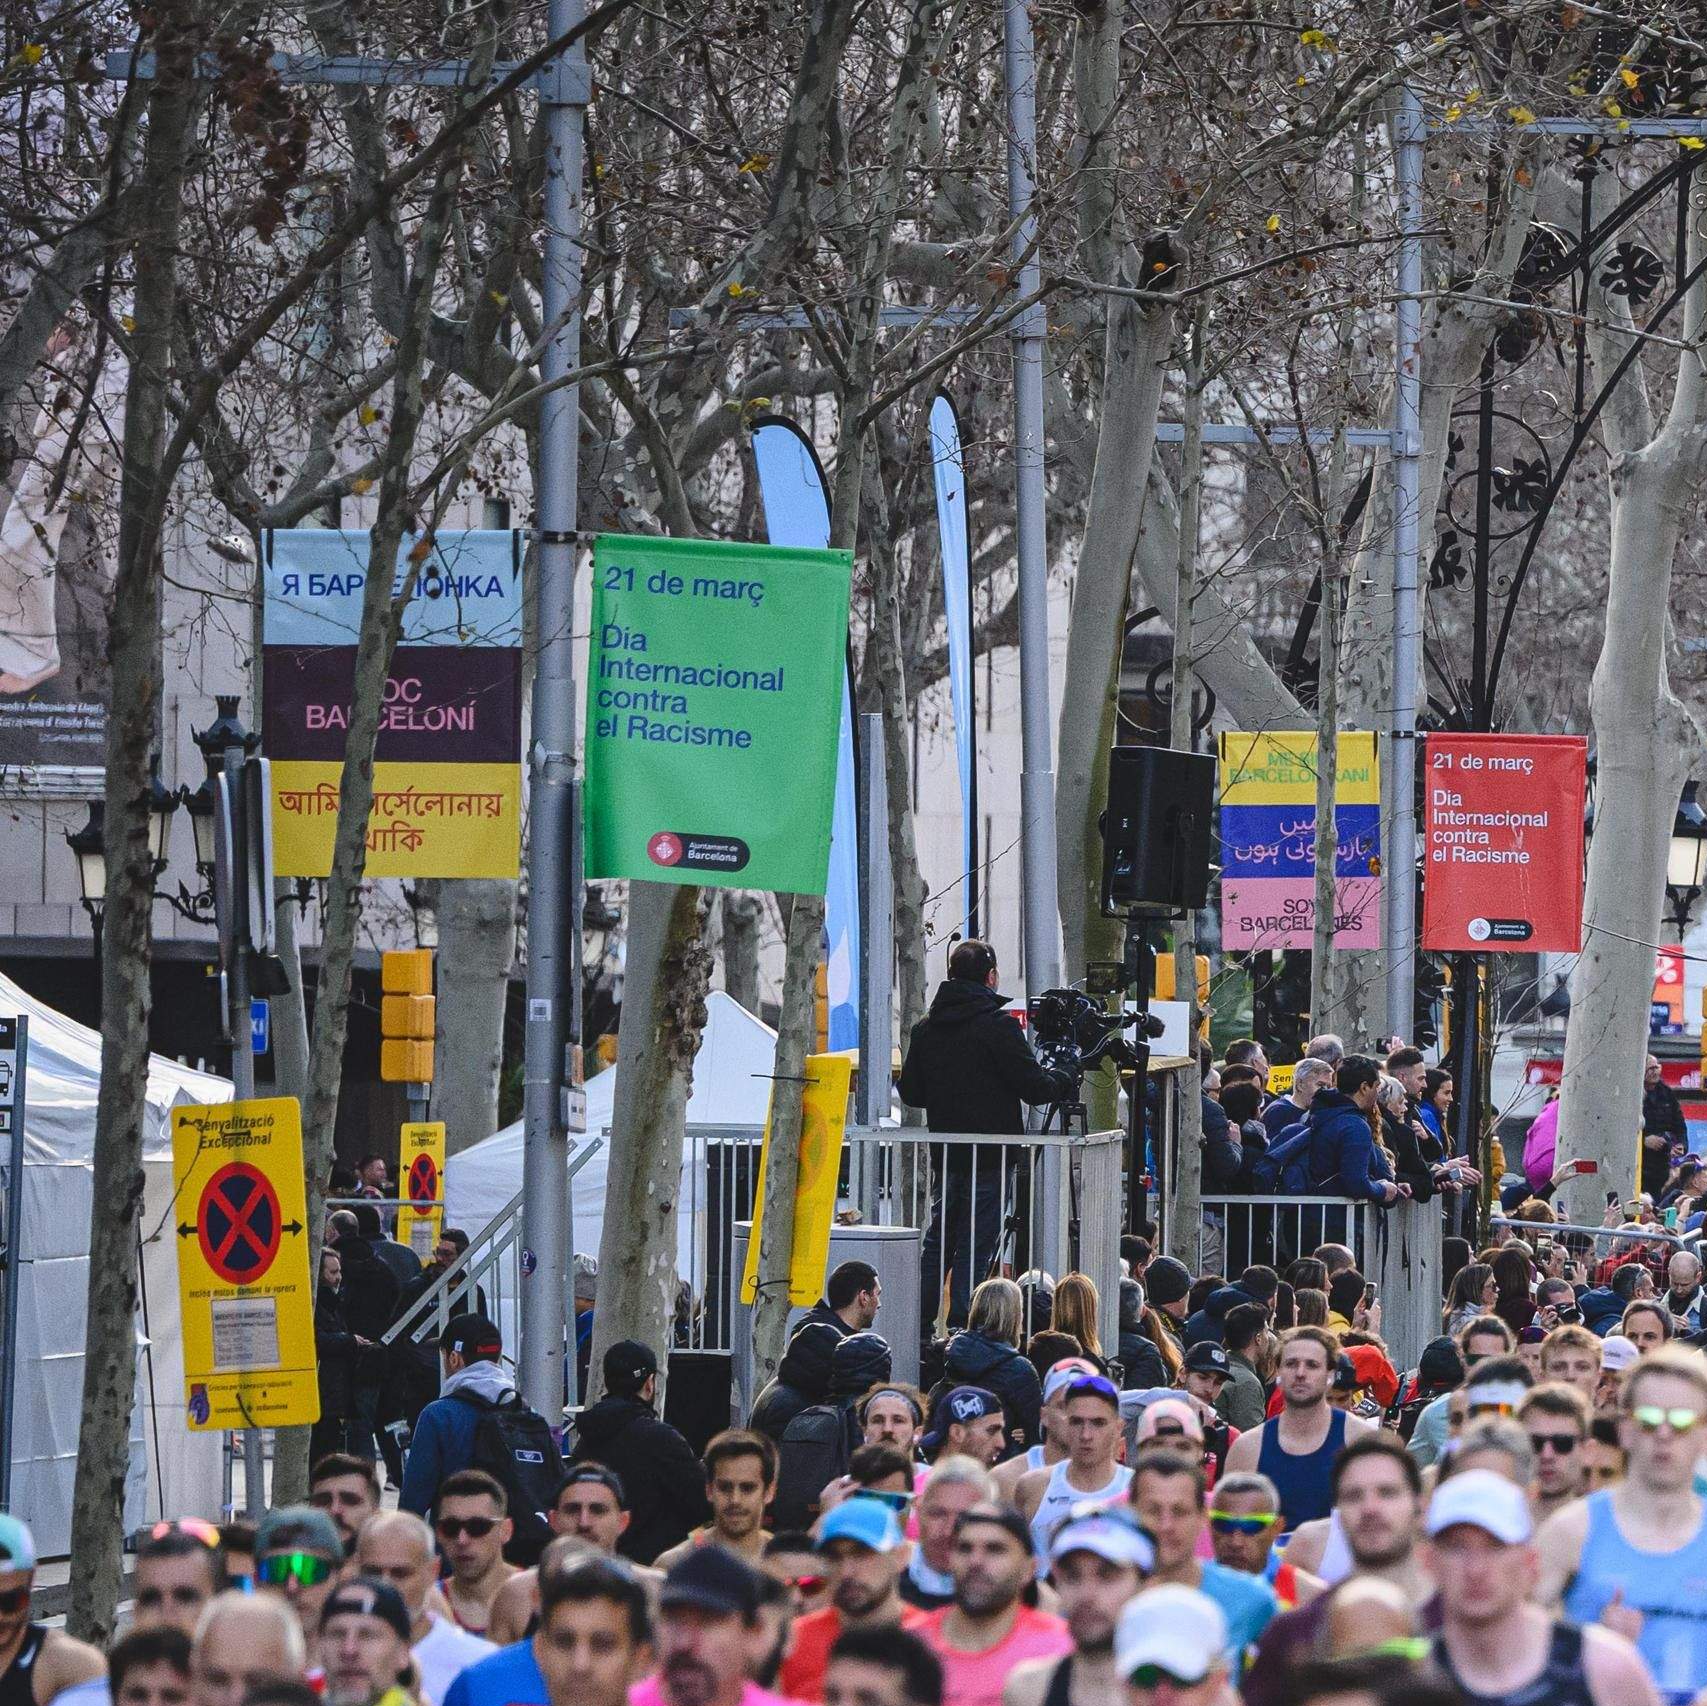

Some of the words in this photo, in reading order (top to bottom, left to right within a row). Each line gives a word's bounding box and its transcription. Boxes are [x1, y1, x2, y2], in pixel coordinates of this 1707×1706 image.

[282, 574, 299, 597] Я
[603, 565, 635, 592] 21
[647, 569, 684, 596] de
[692, 577, 765, 608] març
[601, 624, 648, 652] Dia
[600, 654, 785, 693] Internacional
[382, 677, 423, 703] OC
[597, 688, 688, 715] contra
[595, 714, 618, 739] el
[627, 715, 752, 750] Racisme
[1432, 752, 1453, 769] 21
[1459, 753, 1484, 770] de
[1487, 756, 1534, 776] març
[1432, 789, 1463, 807] Dia
[1432, 808, 1549, 828] Internacional
[688, 841, 729, 853] Ajuntament
[729, 845, 739, 853] de
[1432, 829, 1490, 845] contra
[687, 849, 738, 864] Barcelona
[1432, 846, 1447, 863] el
[1451, 846, 1531, 865] Racisme
